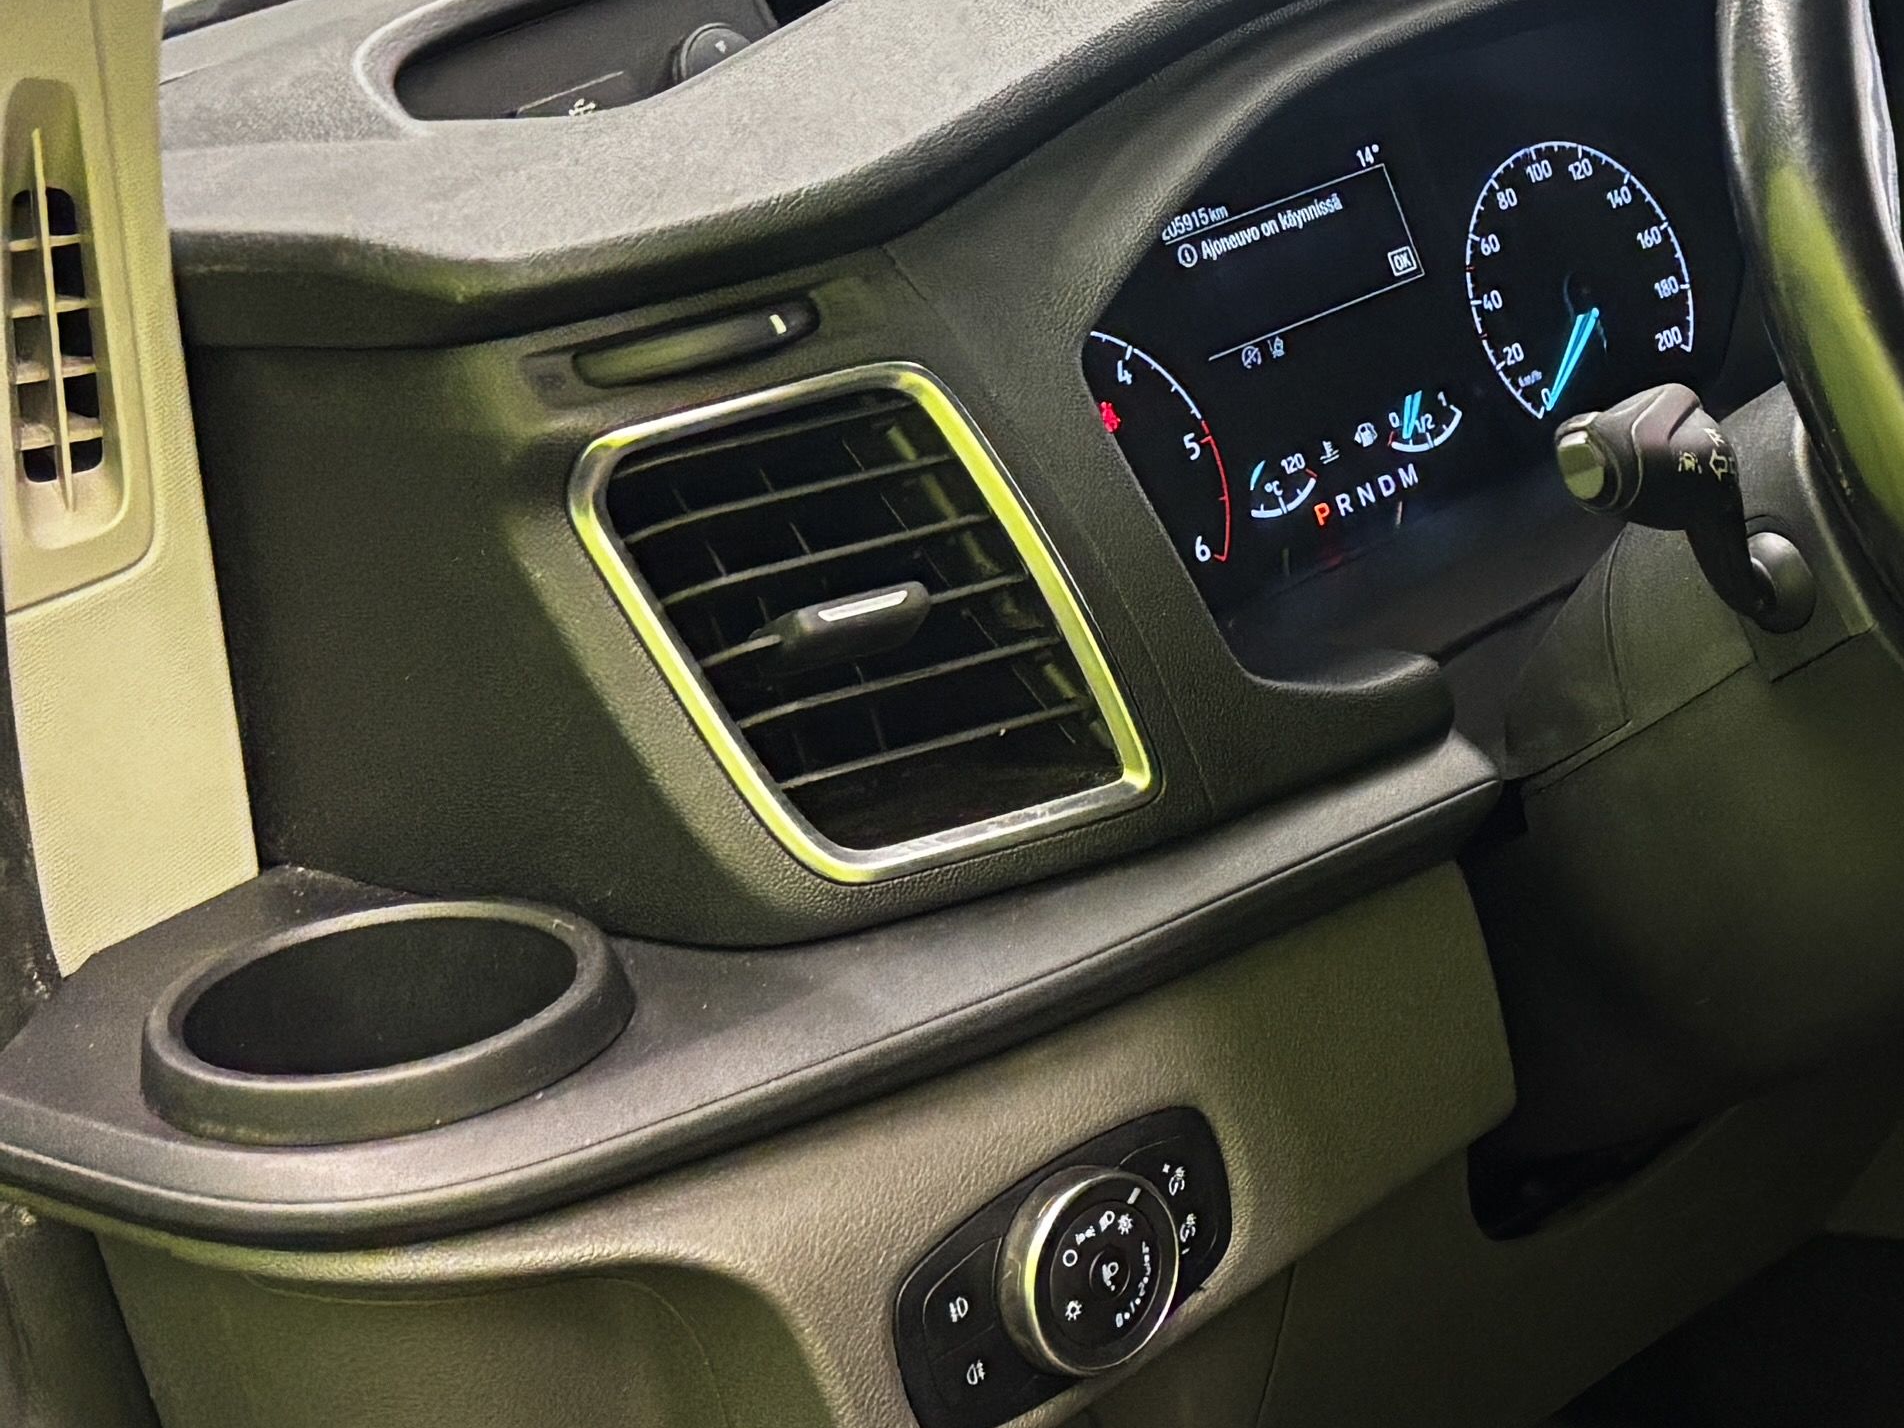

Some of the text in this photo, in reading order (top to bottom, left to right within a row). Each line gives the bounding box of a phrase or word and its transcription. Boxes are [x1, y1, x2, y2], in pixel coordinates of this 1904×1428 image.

[1356, 144, 1380, 167] 14°
[1525, 160, 1552, 183] 100
[1568, 158, 1593, 181] 120
[1497, 187, 1518, 210] 80
[1606, 185, 1632, 209] 140
[1209, 205, 1229, 222] km
[1201, 193, 1343, 261] Ajoneuvo on käynnissä
[1480, 234, 1500, 256] 60
[1636, 228, 1662, 250] 160
[1393, 250, 1411, 272] OK
[1654, 275, 1679, 300] 180
[1482, 289, 1503, 311] 40
[1655, 325, 1682, 353] 200
[1504, 342, 1524, 365] 20
[1117, 359, 1133, 385] 4
[1437, 391, 1447, 406] 1
[1541, 388, 1551, 408] 0
[1388, 412, 1400, 428] 0
[1182, 433, 1200, 461] 5
[1281, 452, 1306, 474] 120
[1313, 463, 1419, 526] P R N D M
[1194, 535, 1211, 562] 6
